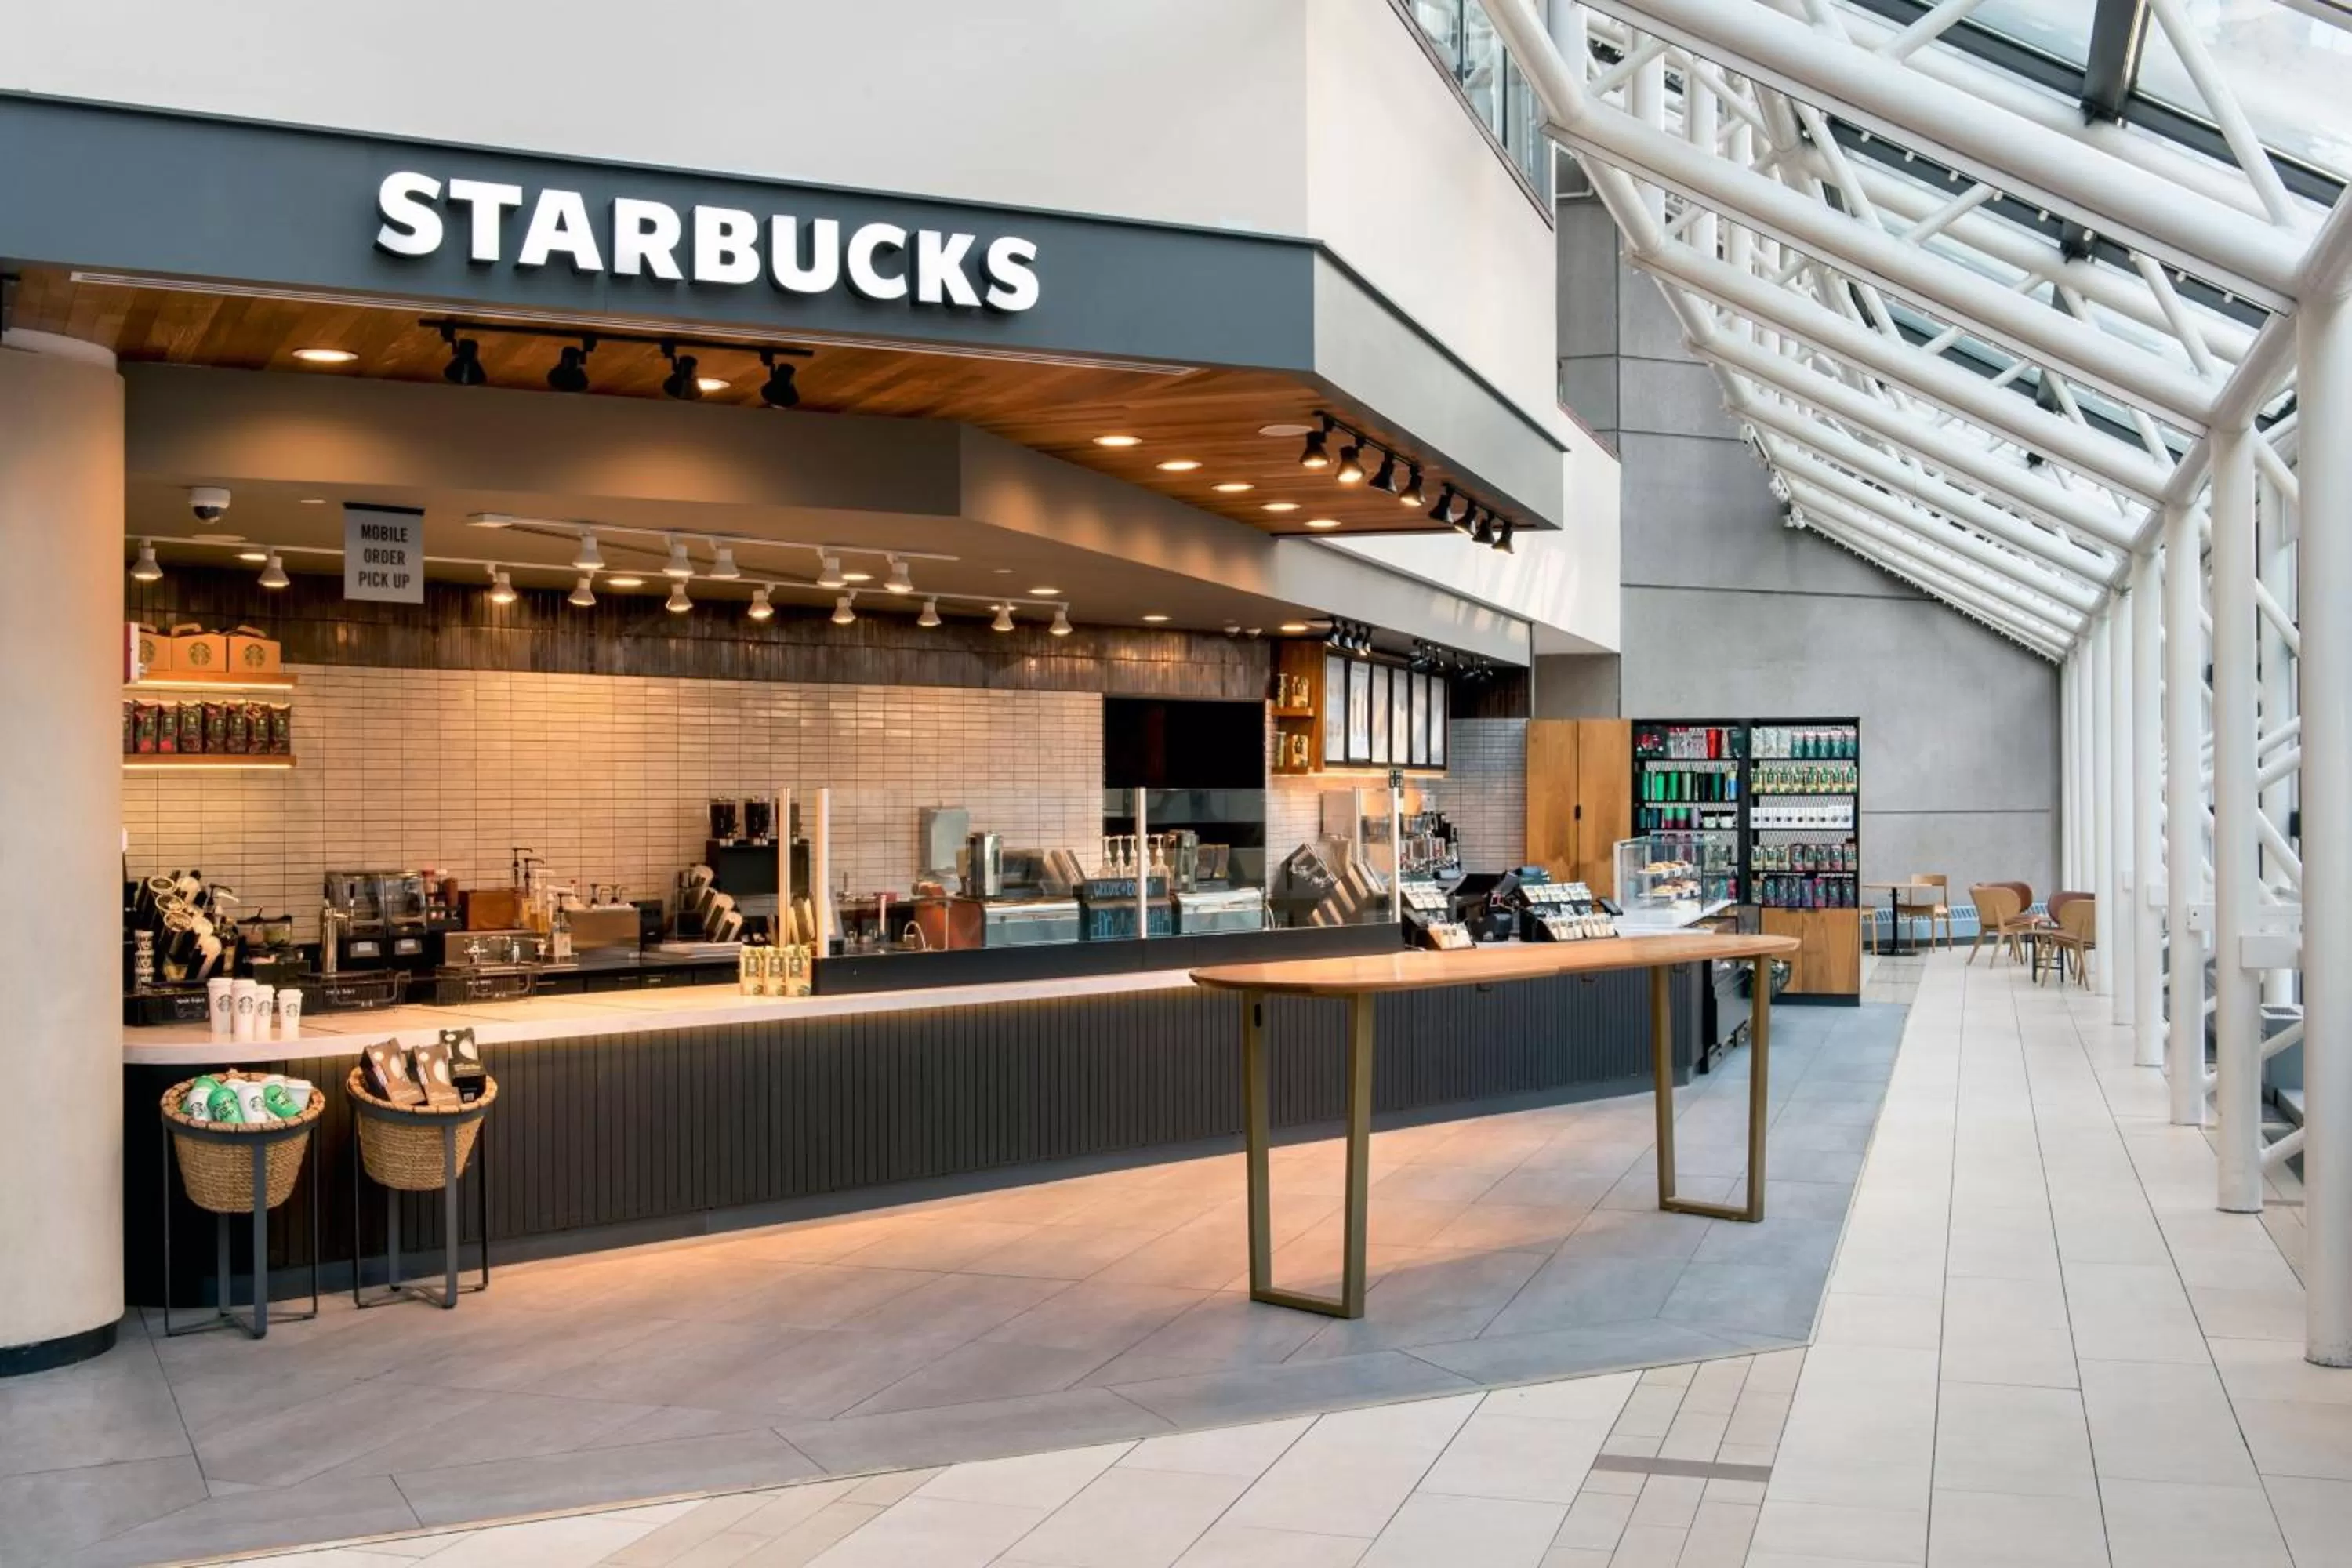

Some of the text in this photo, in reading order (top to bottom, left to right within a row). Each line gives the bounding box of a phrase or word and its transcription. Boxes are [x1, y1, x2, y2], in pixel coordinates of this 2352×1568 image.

[376, 171, 1040, 314] STARBUCKS
[361, 524, 408, 543] MOBILE
[363, 547, 406, 566] ORDER
[358, 570, 411, 590] PICK UP
